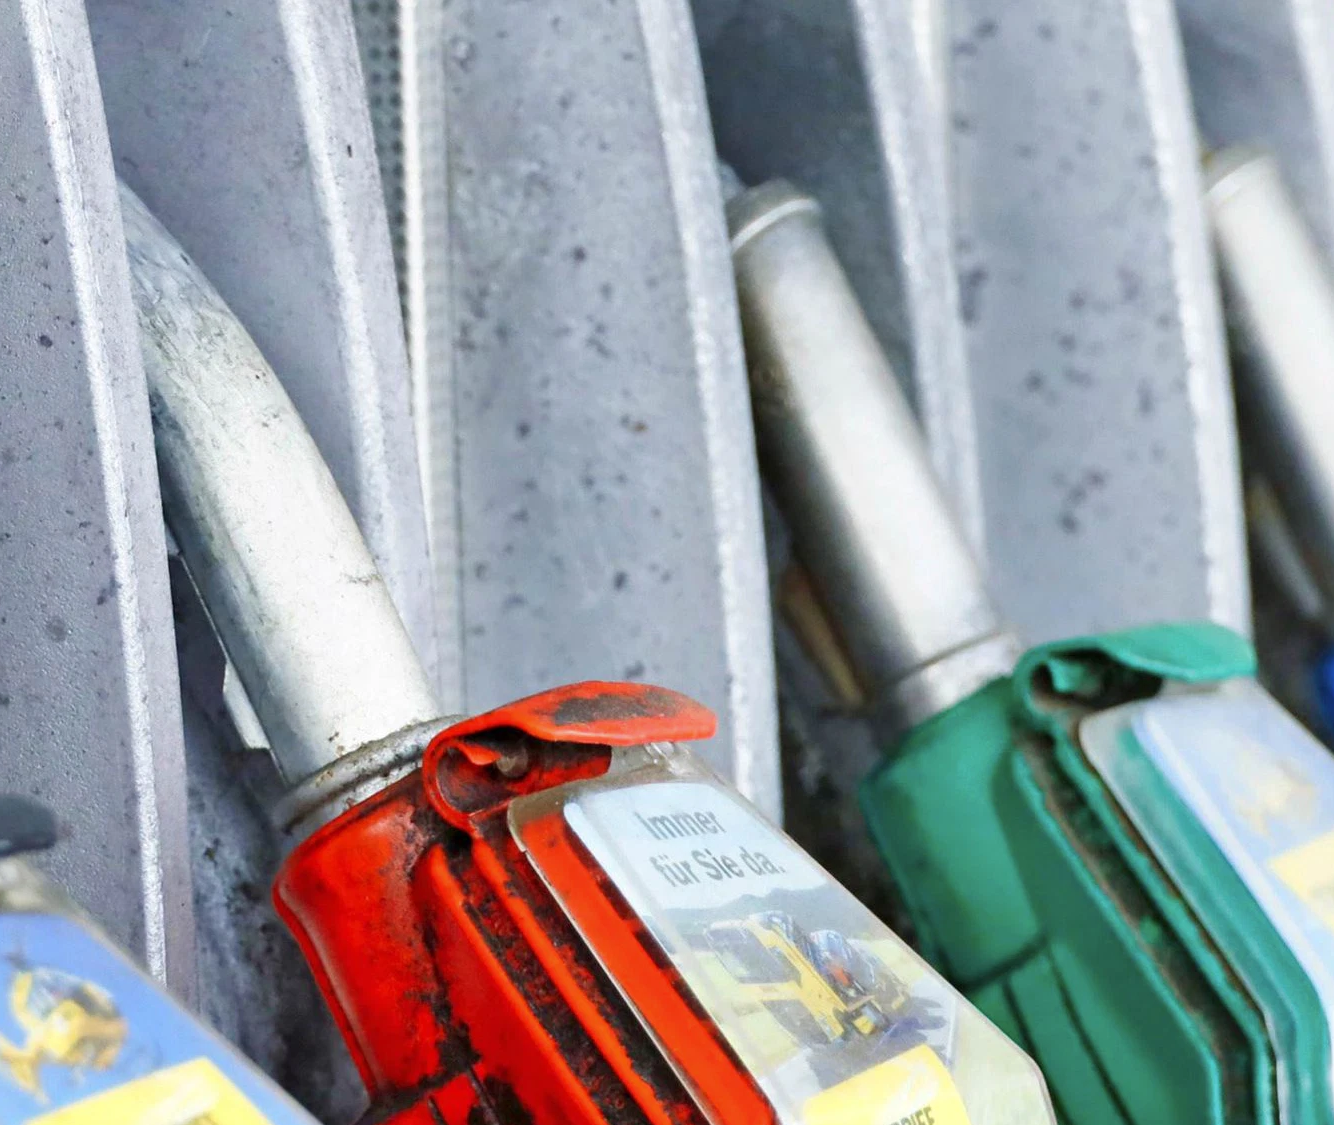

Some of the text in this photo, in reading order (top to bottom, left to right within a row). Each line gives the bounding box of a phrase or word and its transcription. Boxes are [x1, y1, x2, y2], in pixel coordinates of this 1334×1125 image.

[633, 811, 727, 841] Immer
[649, 845, 786, 887] für Sie da.
